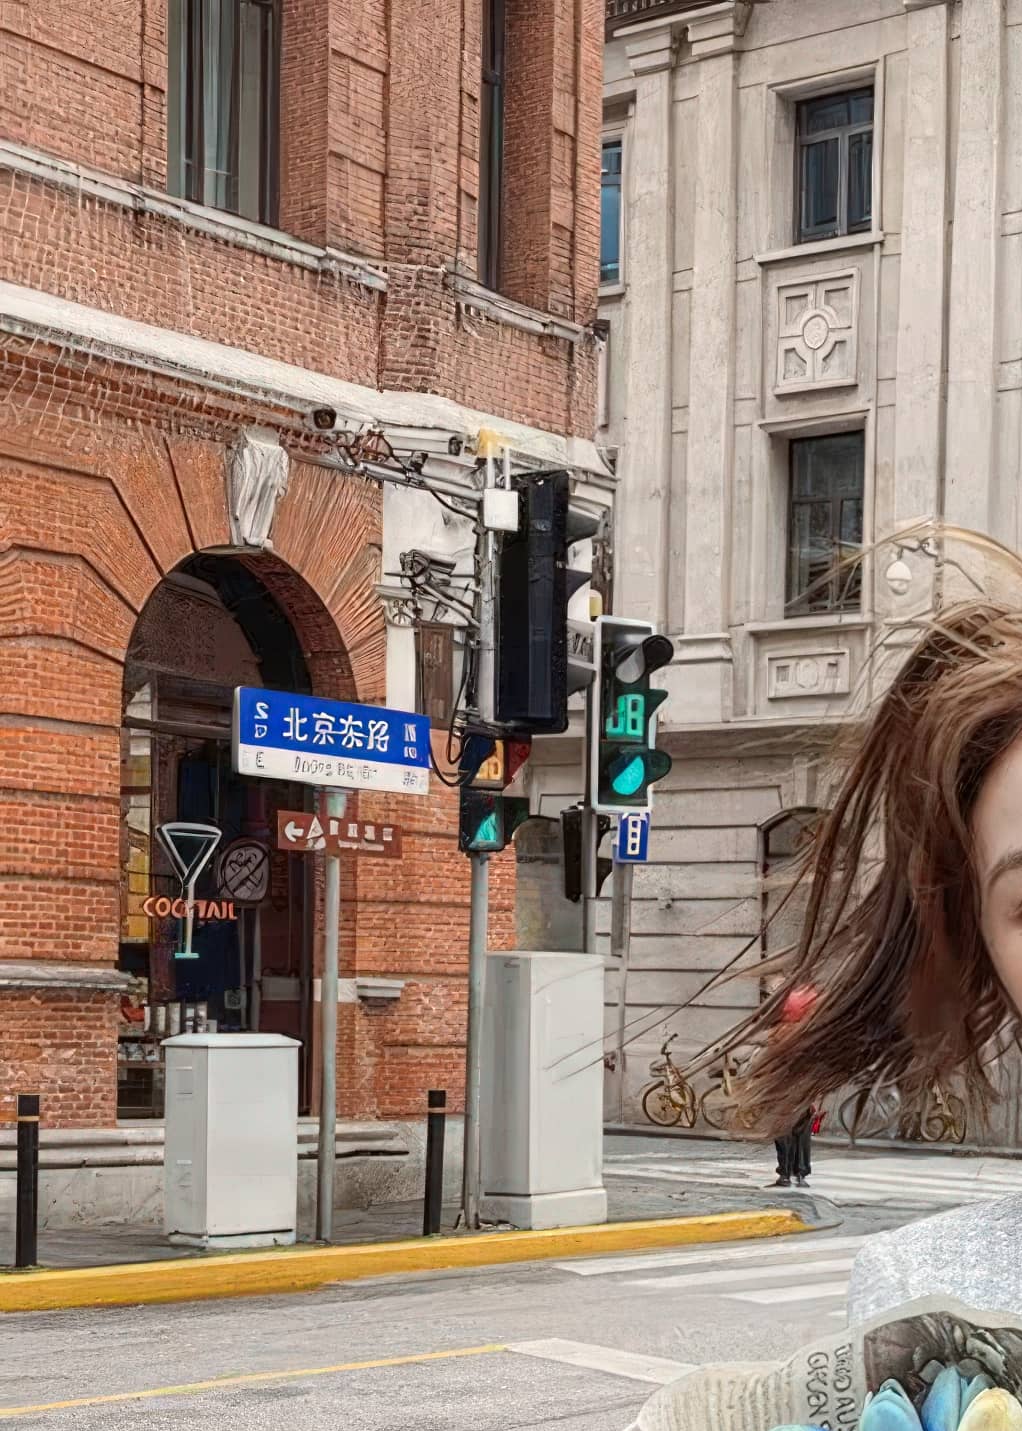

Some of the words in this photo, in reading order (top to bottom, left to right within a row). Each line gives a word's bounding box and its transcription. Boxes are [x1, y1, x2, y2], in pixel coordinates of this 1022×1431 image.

[282, 706, 390, 753] 北京东路
[143, 896, 239, 921] COCTAIL
